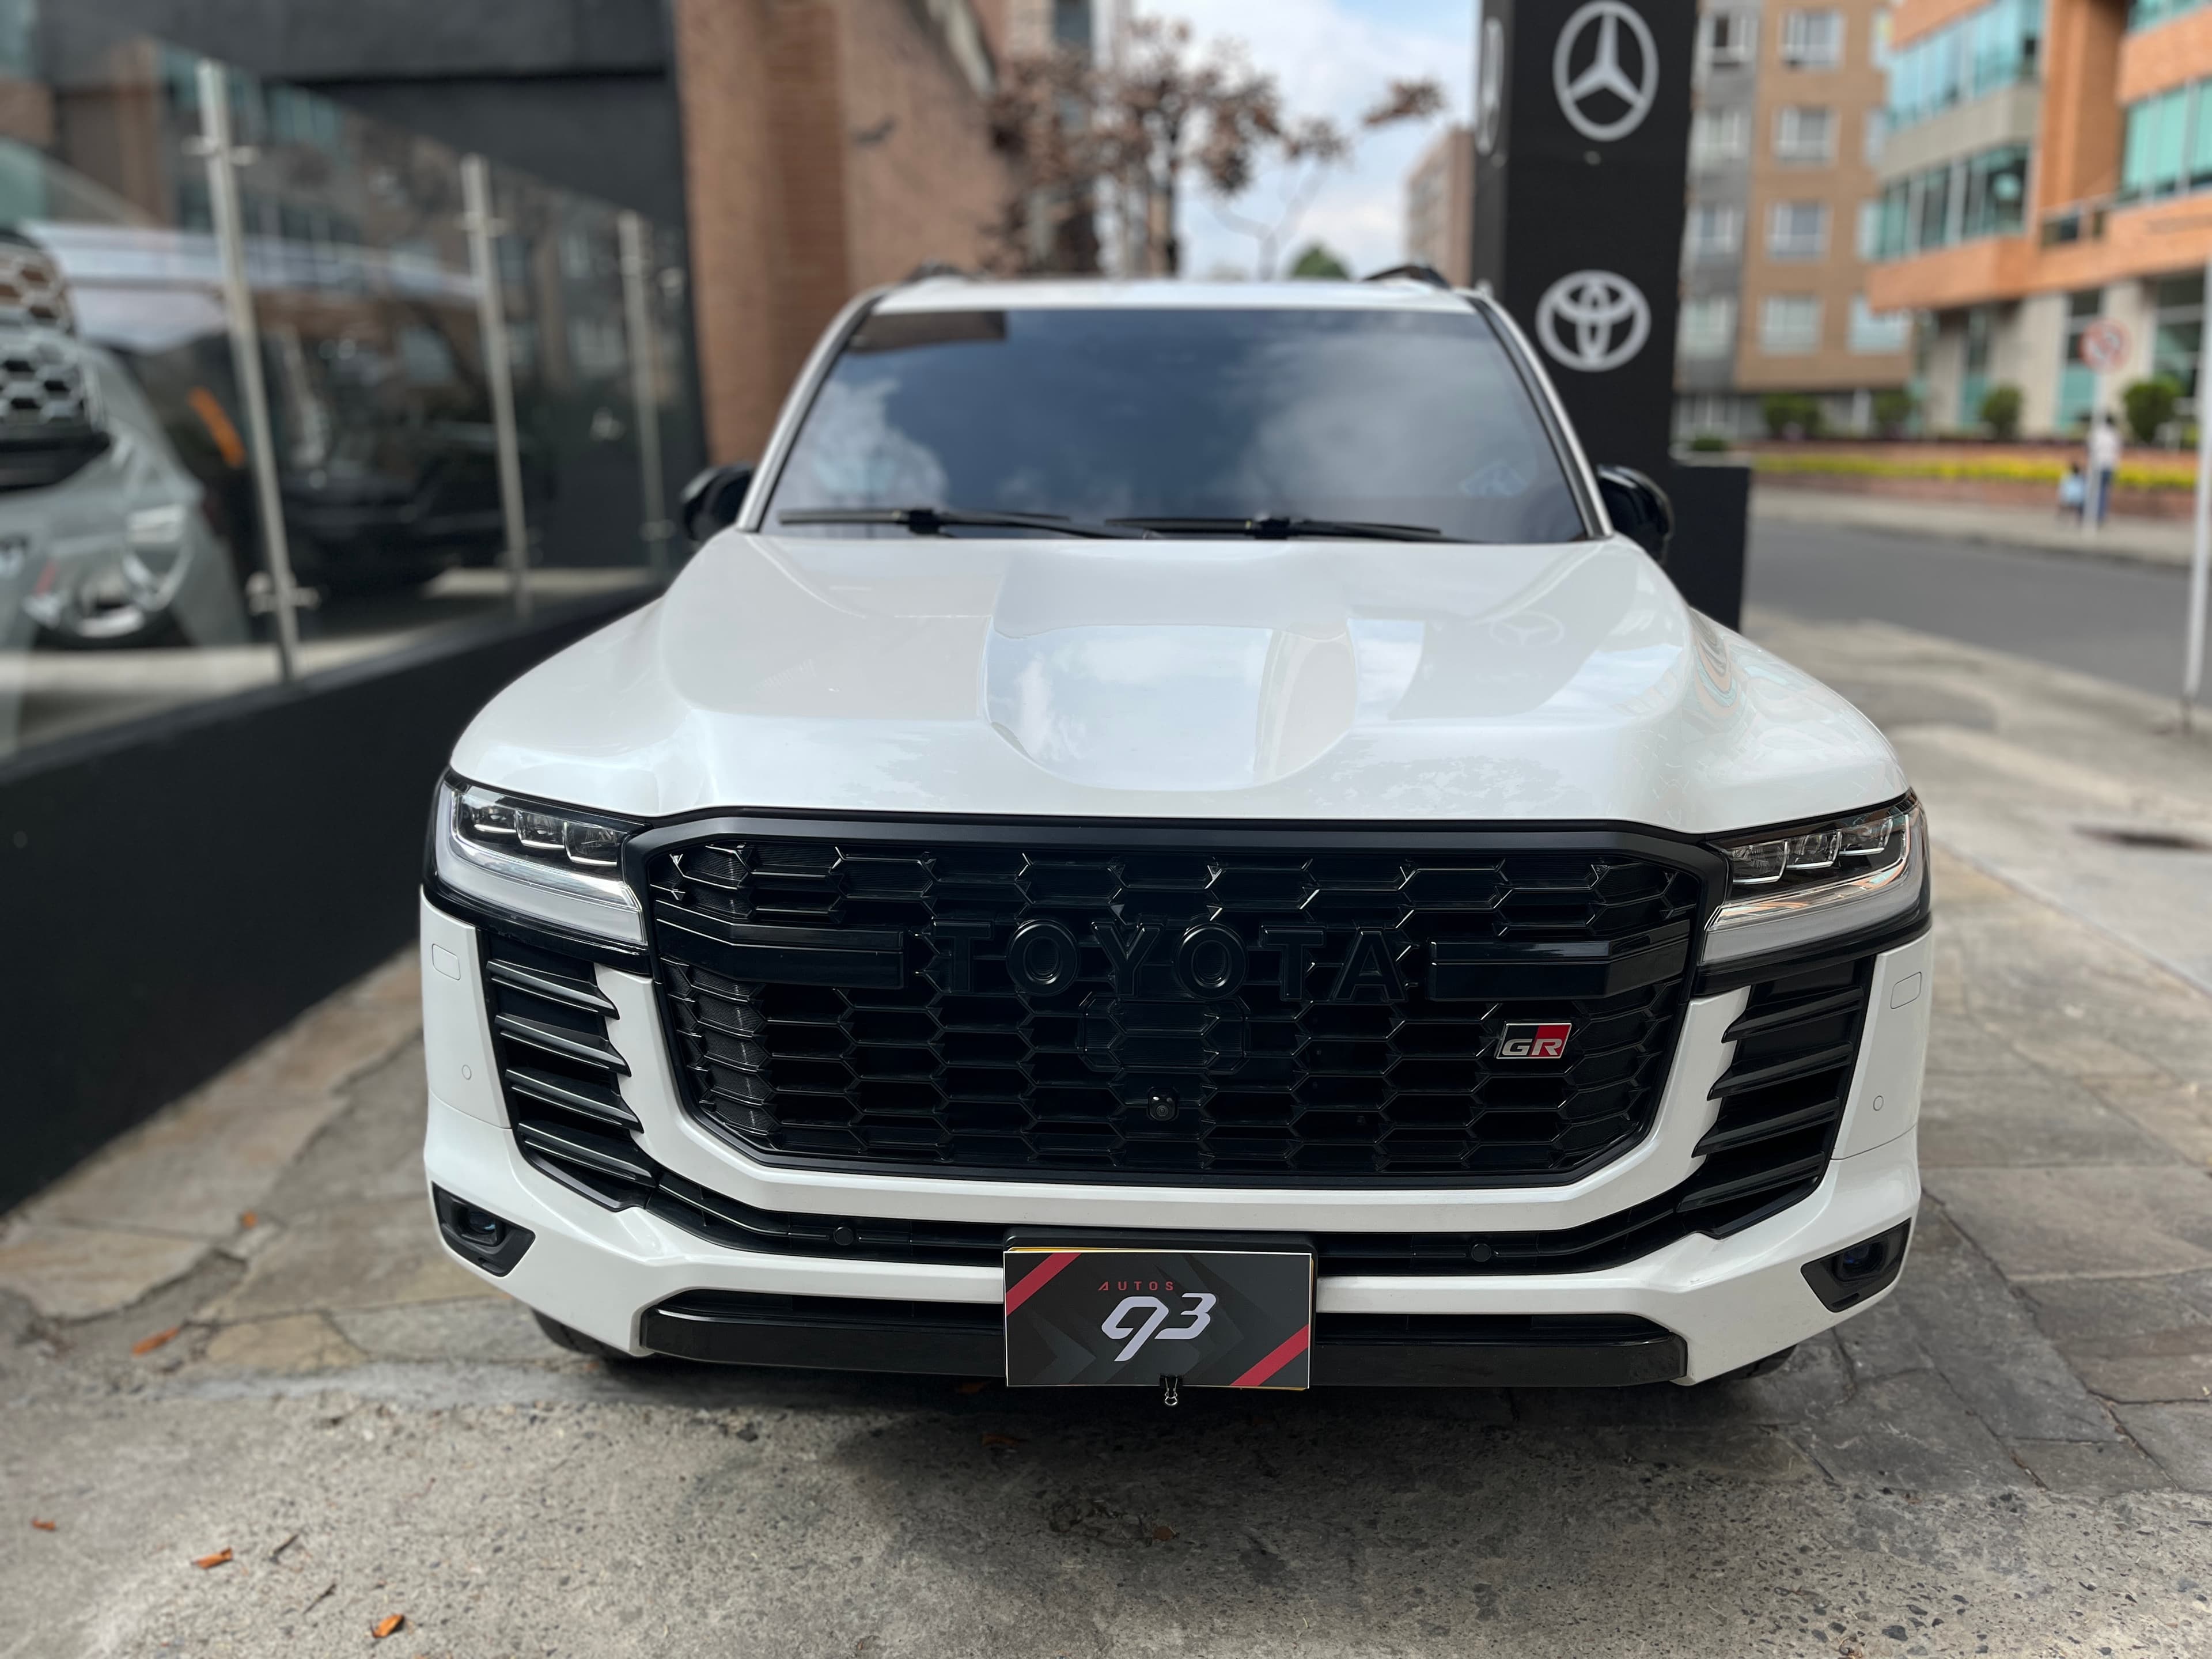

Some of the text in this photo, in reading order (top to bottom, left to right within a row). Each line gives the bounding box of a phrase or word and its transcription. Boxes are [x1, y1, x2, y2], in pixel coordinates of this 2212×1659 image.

[931, 919, 1407, 1001] TOYOTA
[1502, 1039, 1562, 1055] GR
[1099, 1282, 1173, 1291] AUTOS
[1101, 1293, 1217, 1361] 93
